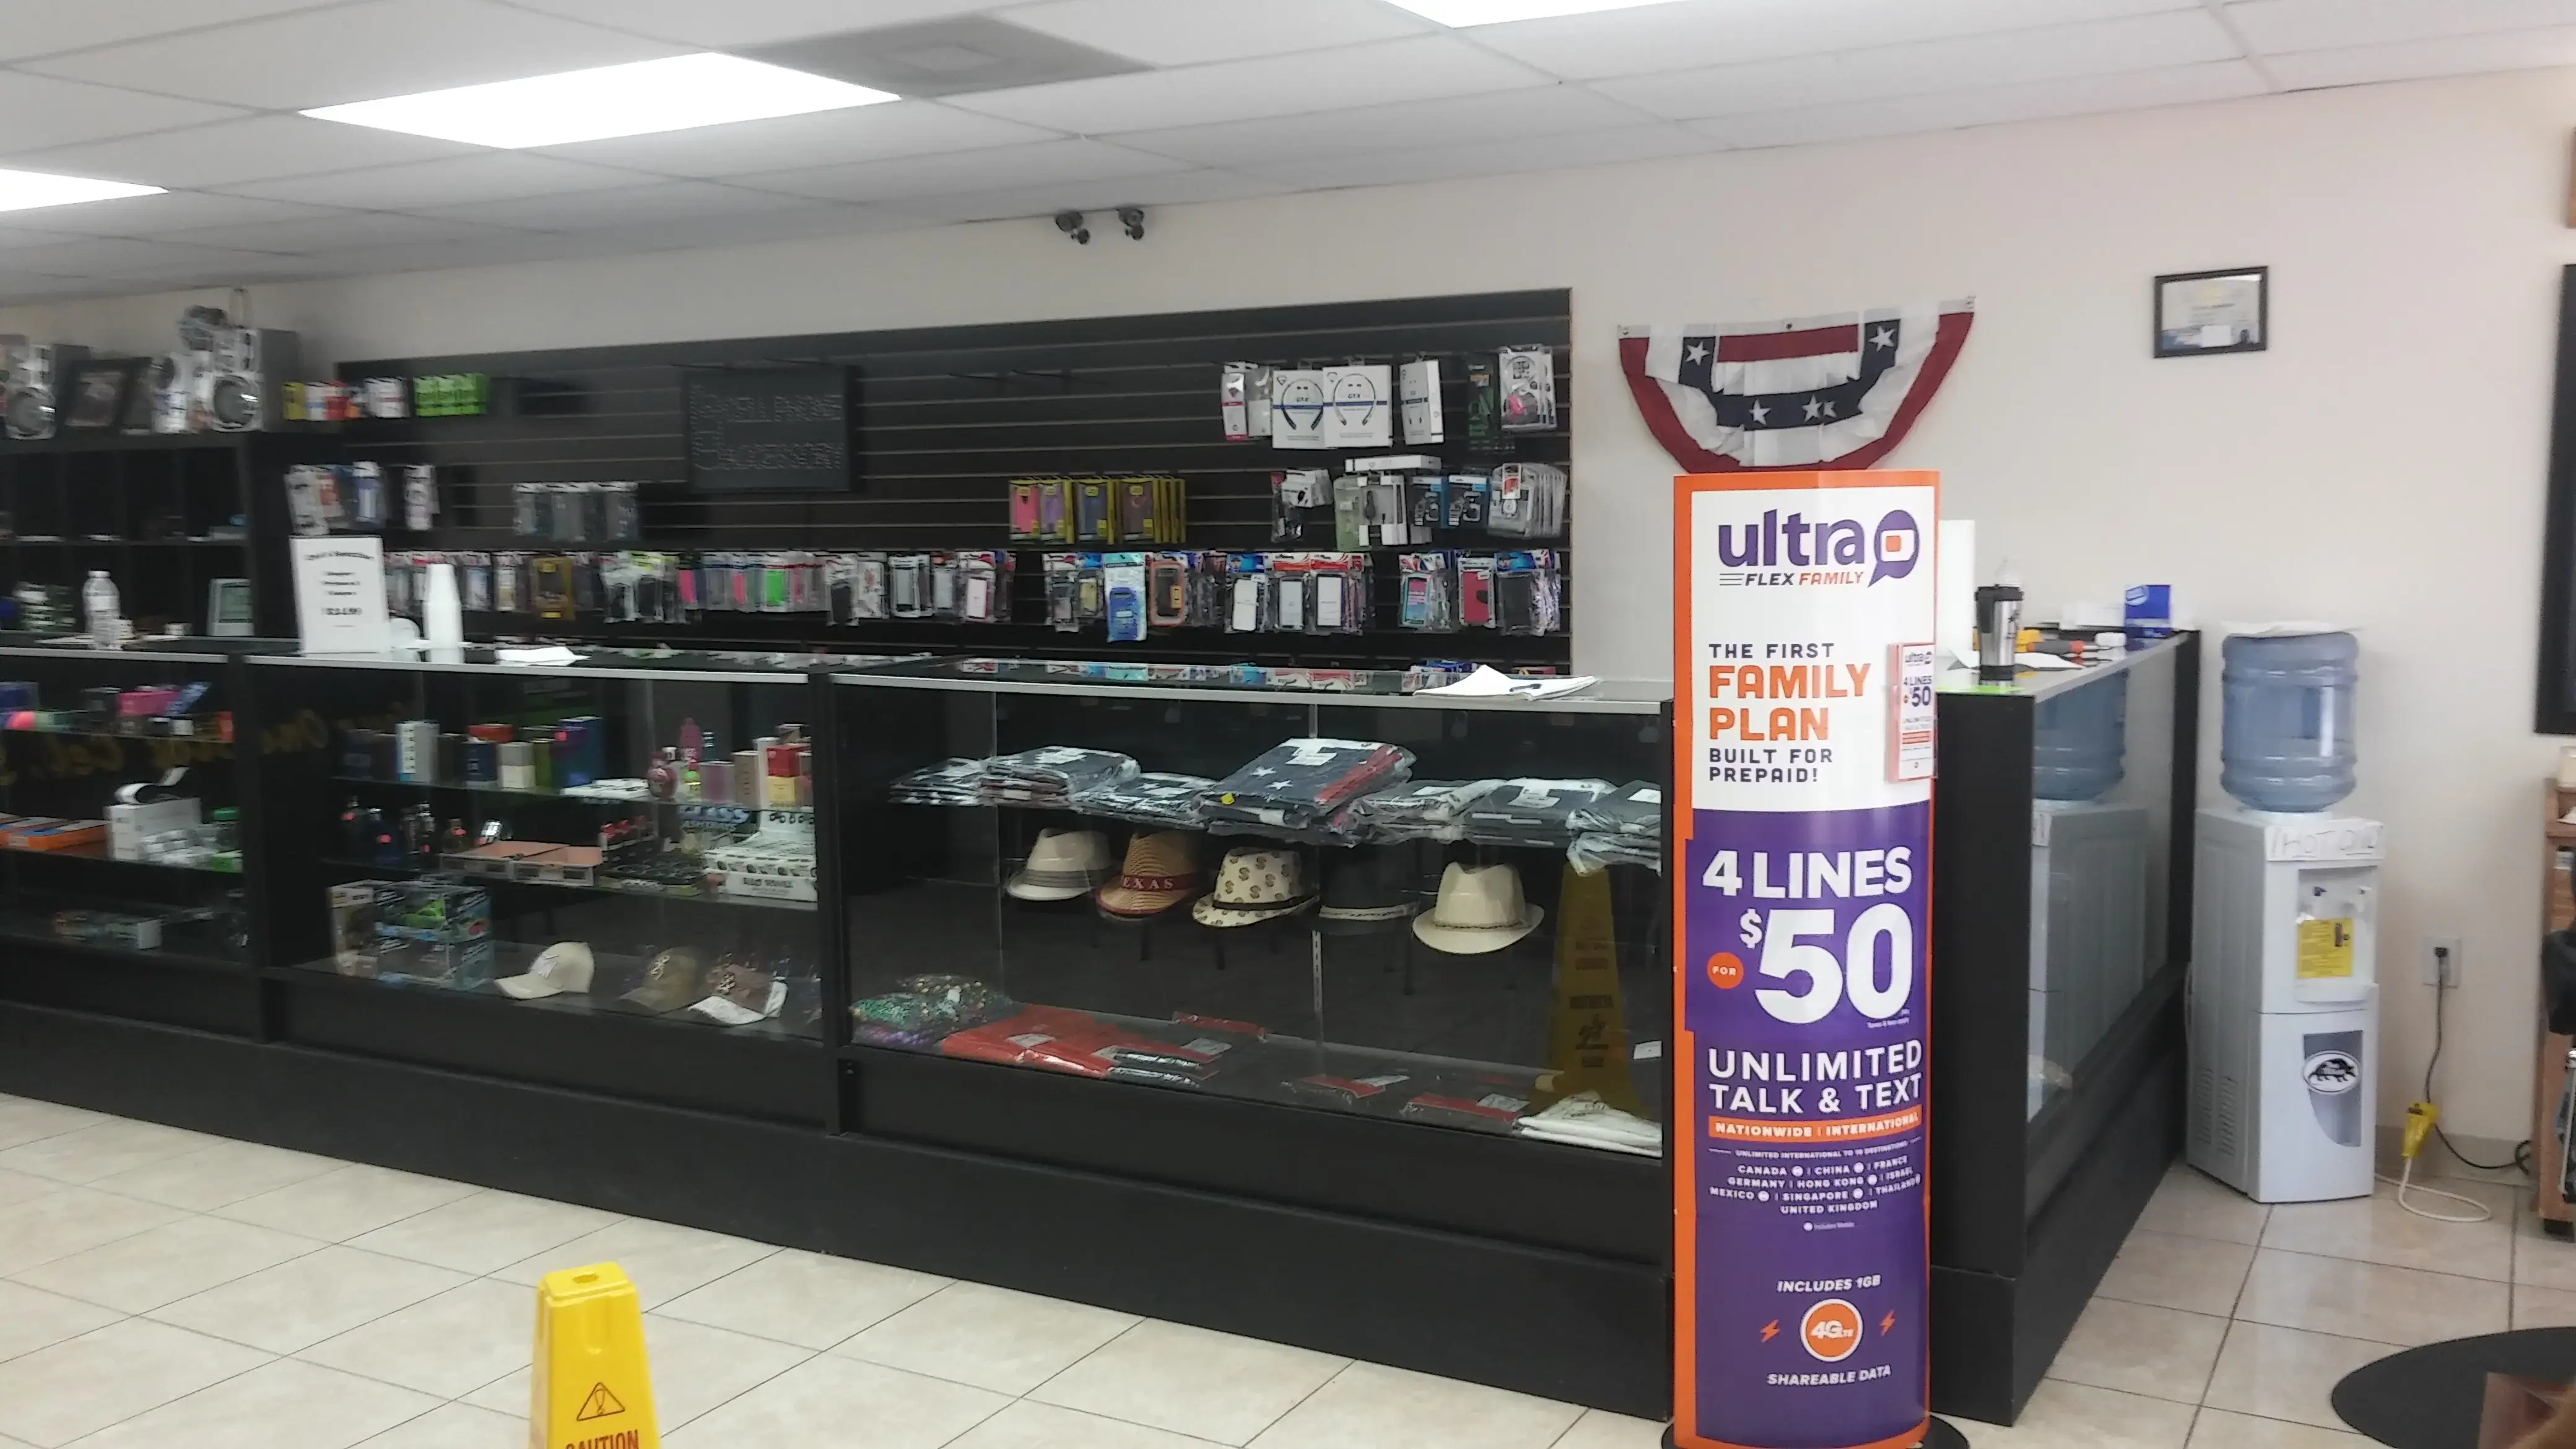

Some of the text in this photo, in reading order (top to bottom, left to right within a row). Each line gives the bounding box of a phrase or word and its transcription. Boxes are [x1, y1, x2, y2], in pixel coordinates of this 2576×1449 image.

[1718, 508, 1865, 567] ultra
[1745, 571, 1865, 586] FLEX FAMILY
[1709, 643, 1834, 658] THE FIRST
[1709, 663, 1871, 699] FAMILY
[1709, 707, 1829, 741] PLAN
[1709, 748, 1833, 764] BUILT FOR
[1709, 768, 1819, 783] PREPAID!
[1121, 876, 1173, 889] EXAS
[1702, 846, 1912, 899] 4 LINES
[1712, 965, 1737, 977] FOR
[1739, 903, 1913, 1024] $50
[1708, 1039, 1921, 1082] UNLIMITED
[1708, 1073, 1921, 1114] TALK & TEXT
[1715, 1112, 1920, 1138] NATIONWIDE INTERNATIONAL
[1734, 1149, 1779, 1159] UNLIMITED
[1780, 1150, 1842, 1159] INTERNATIONAL
[1736, 1154, 1908, 1176] CANADA CHINA FRANCE
[1727, 1177, 1786, 1189] GERMANY
[1796, 1178, 1830, 1188] HONG
[1834, 1176, 1865, 1187] KONG
[1708, 1186, 1755, 1200] MEXICO
[1782, 1190, 1849, 1202] SINGAPORE
[1780, 1199, 1879, 1215] UNITED KINGDOM
[1777, 1274, 1882, 1294] INCLUDES 1GB
[1767, 1364, 1892, 1386] SHAREABLE DATA
